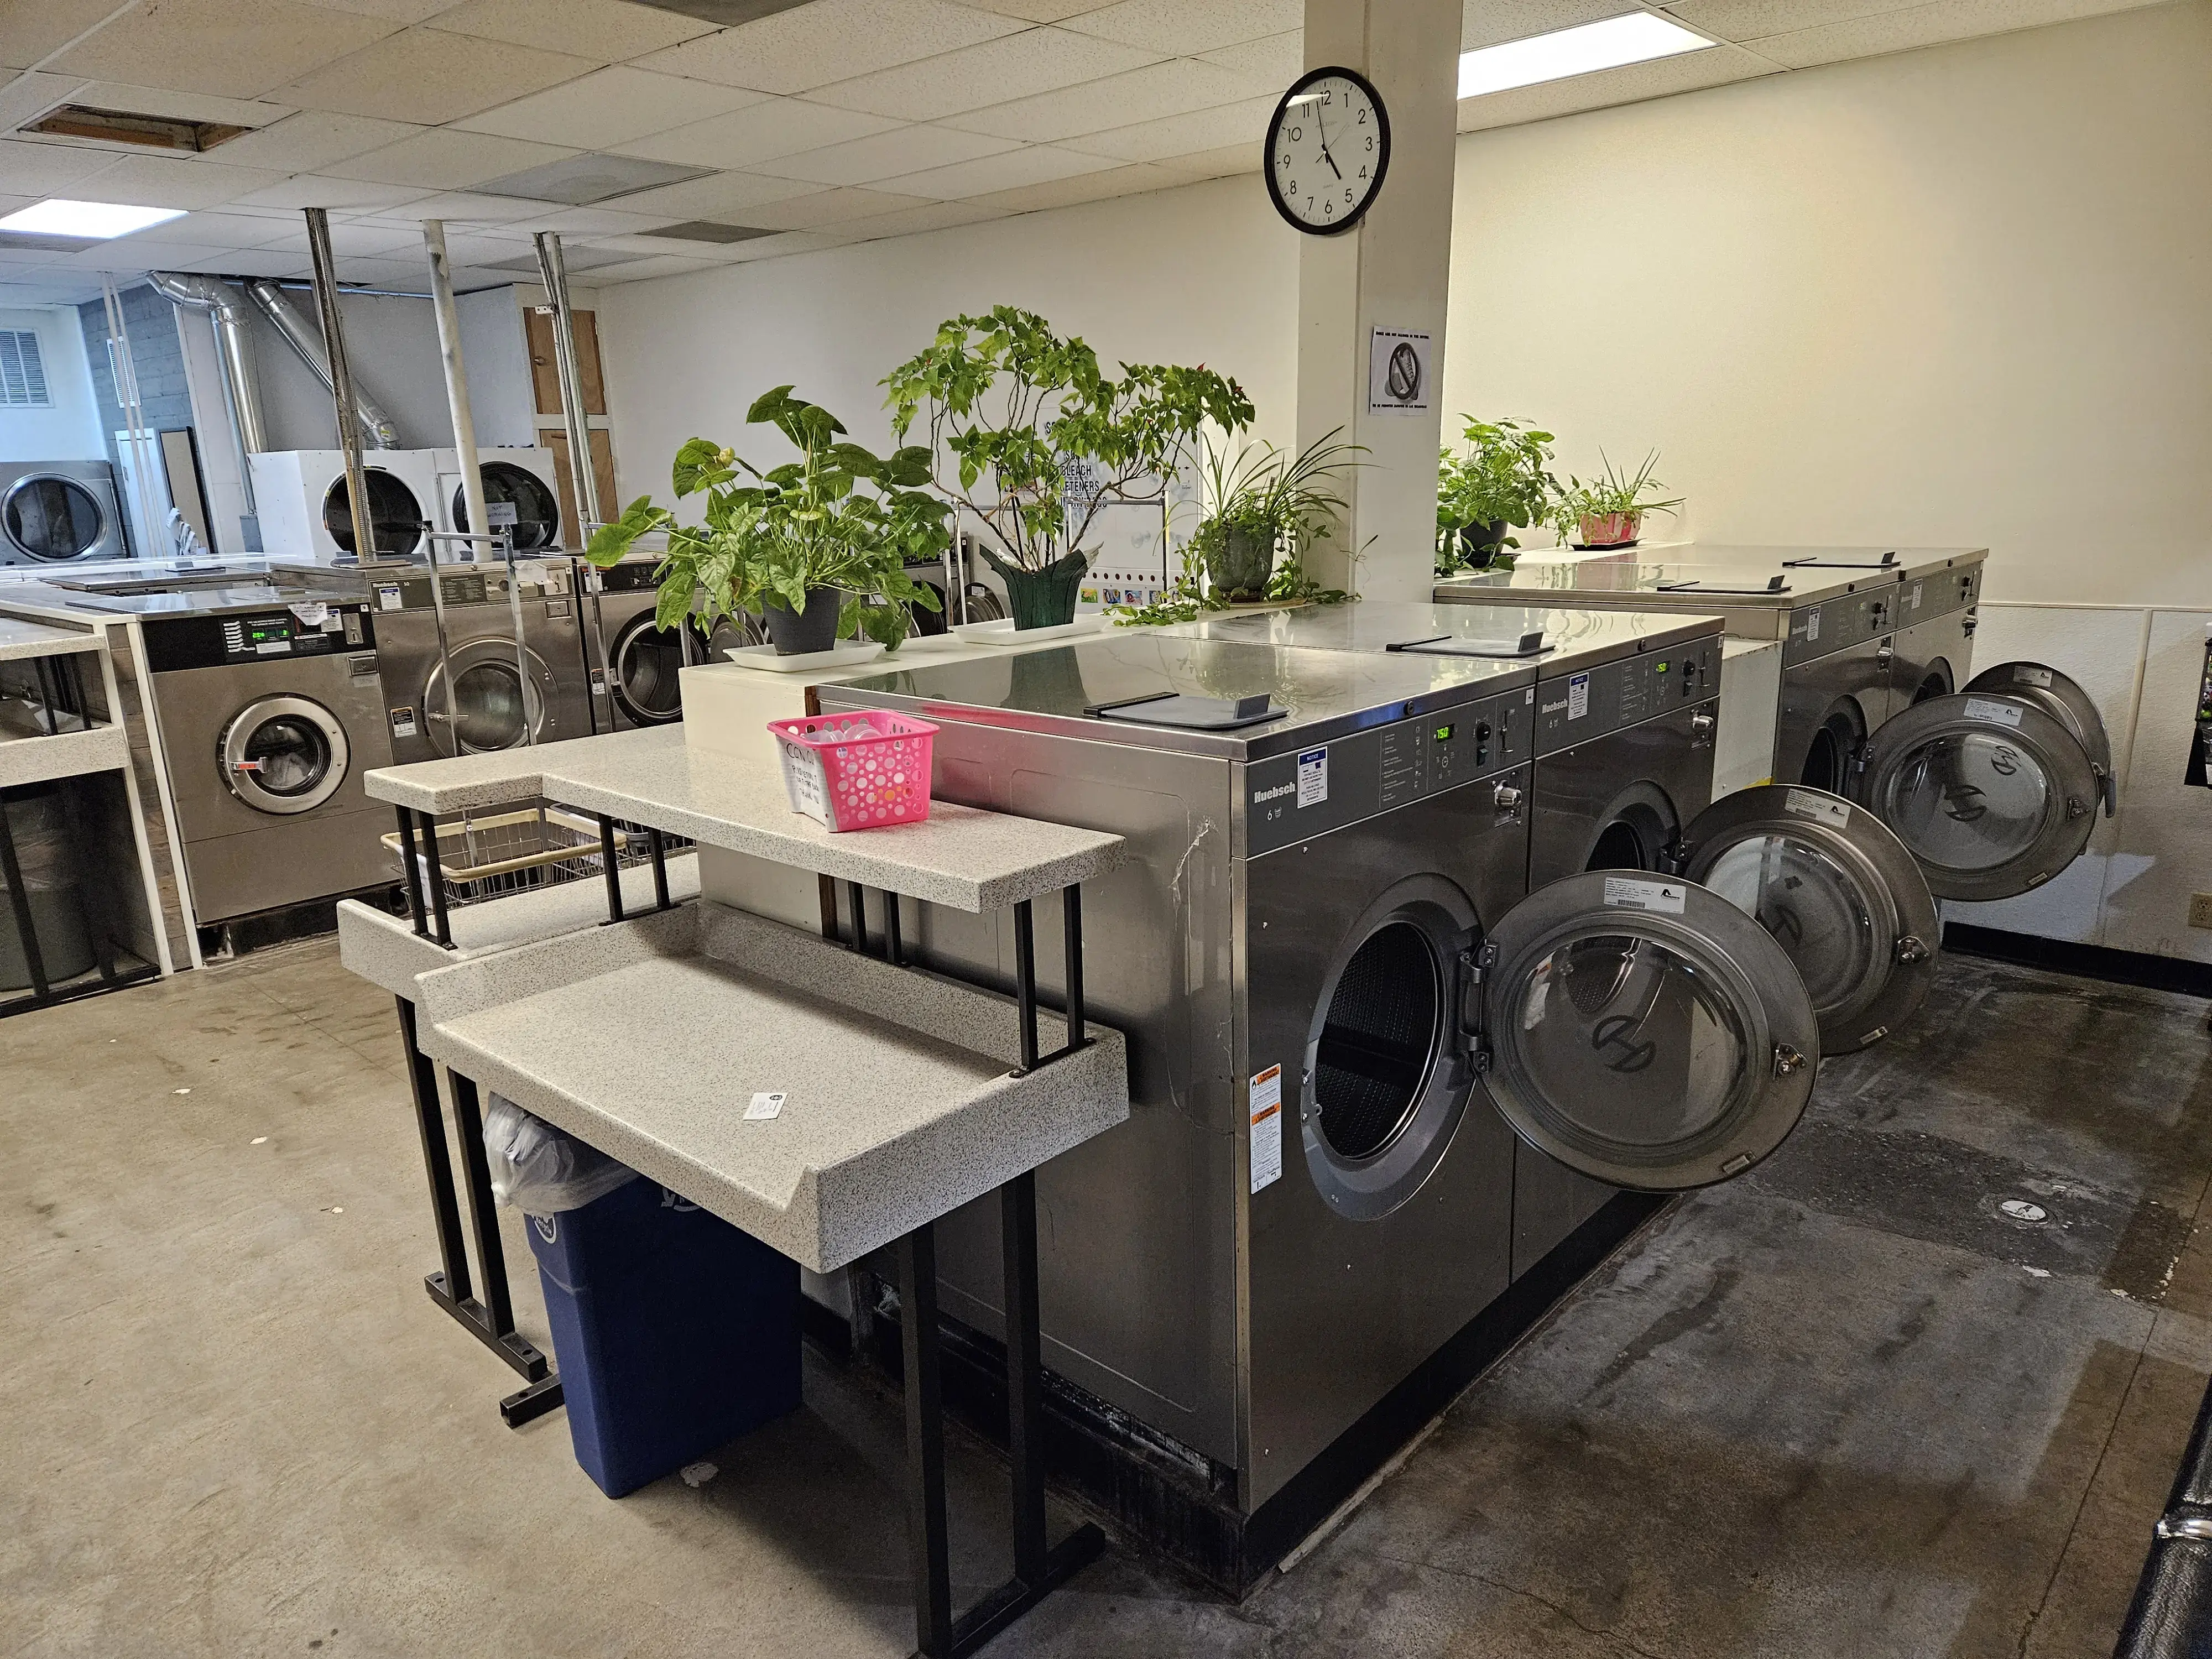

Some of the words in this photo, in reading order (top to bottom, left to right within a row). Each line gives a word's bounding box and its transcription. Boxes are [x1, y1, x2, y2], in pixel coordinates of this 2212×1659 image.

[1321, 90, 1331, 106] 12
[1344, 93, 1348, 107] 1
[1302, 103, 1309, 118] 11
[1358, 109, 1366, 124] 2
[1287, 127, 1302, 143] 10
[1365, 137, 1373, 151] 3
[1284, 155, 1291, 169] 9
[1358, 165, 1366, 179] 4
[1290, 180, 1297, 195] 8
[1345, 189, 1353, 203] 5
[1307, 196, 1314, 211] 7
[1324, 199, 1332, 213] 6
[1254, 781, 1295, 804] Huebsch
[1267, 810, 1272, 821] 6
